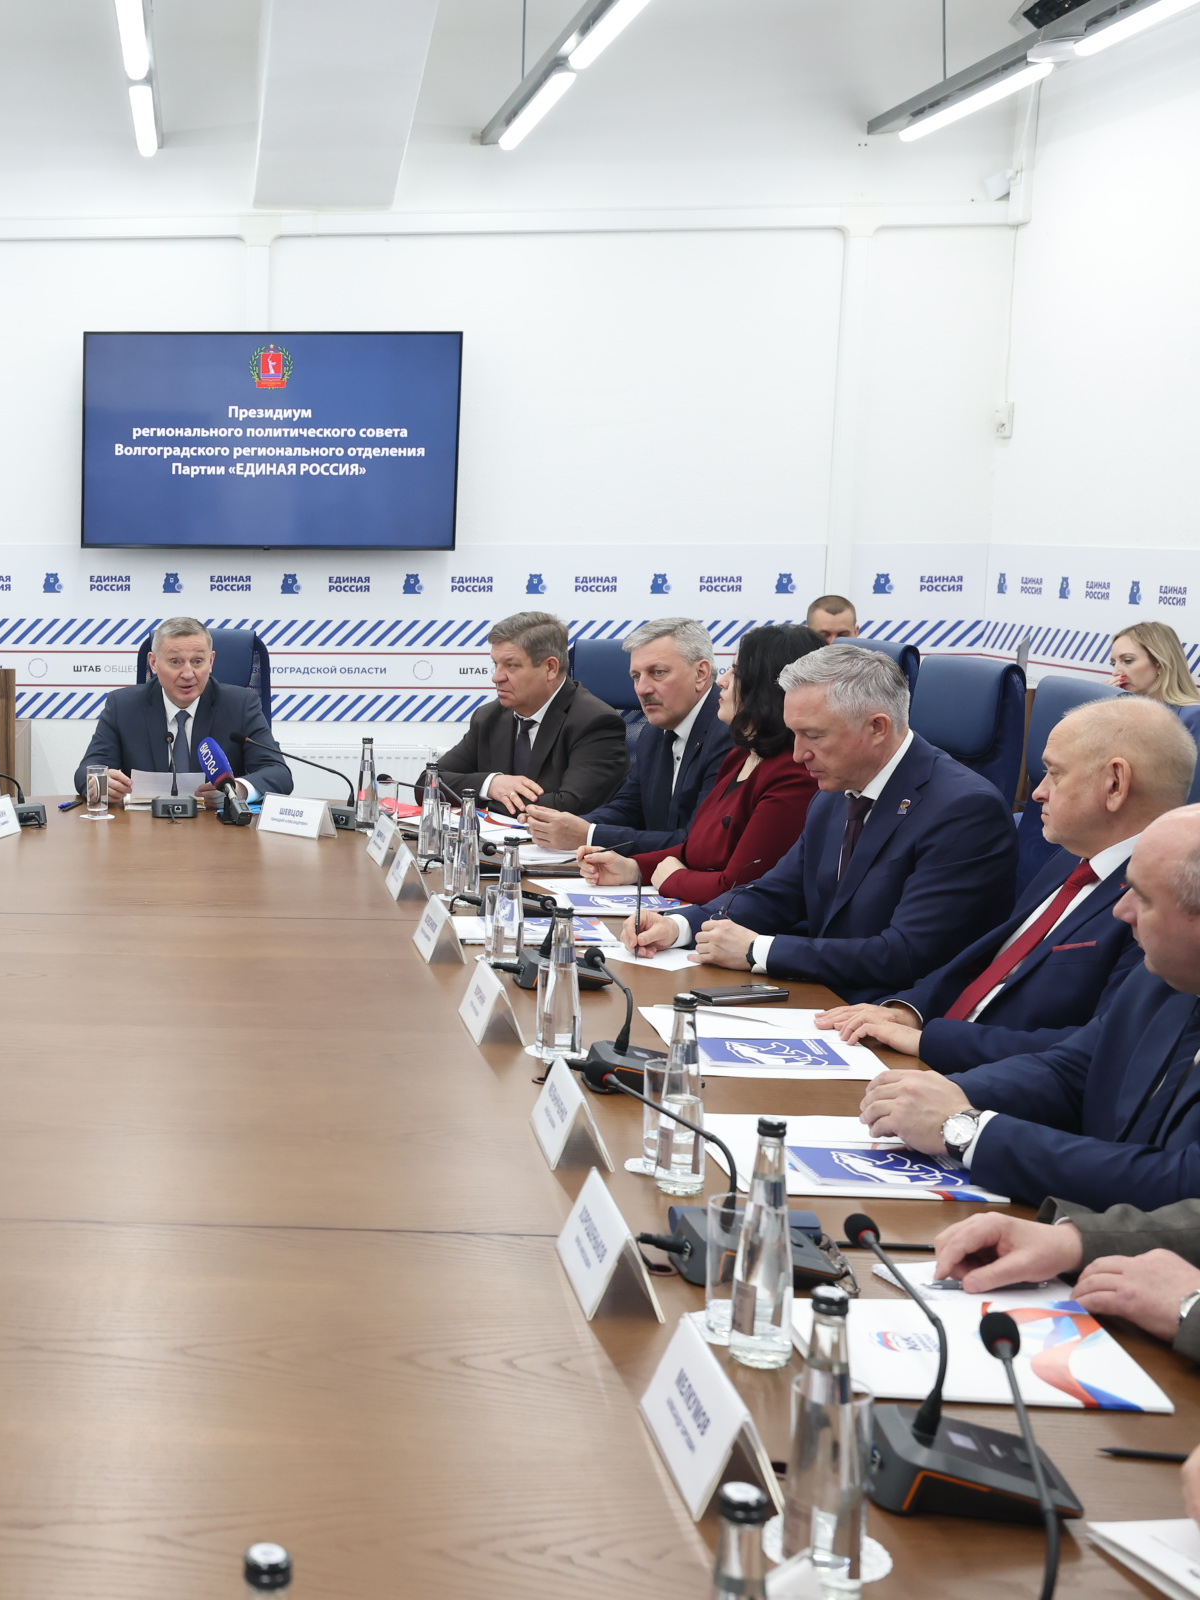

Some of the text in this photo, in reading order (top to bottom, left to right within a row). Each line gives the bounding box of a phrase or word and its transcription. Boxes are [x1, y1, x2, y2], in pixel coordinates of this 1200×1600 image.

[228, 406, 312, 422] Президиум
[132, 427, 408, 440] регионального политического совета
[114, 444, 426, 460] Волгоградского регионального отделения
[171, 463, 367, 478] Партии «ЕДИНАЯ РОССИЯ»
[89, 576, 130, 584] ЕДИНАЯ
[210, 576, 251, 584] ЕДИНАЯ
[328, 576, 370, 584] ЕДИНАЯ
[451, 577, 493, 585] ЕДИНАЯ
[575, 577, 617, 585] ЕДИНАЯ
[700, 576, 742, 584] ЕДИНАЯ
[920, 576, 963, 584] ЕДИНАЯ
[1021, 577, 1043, 585] ЕДИНАЯ
[89, 584, 130, 592] РОССИЯ
[210, 584, 251, 592] РОССИЯ
[328, 584, 370, 592] РОССИЯ
[451, 585, 493, 593] РОССИЯ
[575, 585, 617, 593] РОССИЯ
[700, 584, 742, 592] РОССИЯ
[920, 584, 963, 592] РОССИЯ
[1085, 581, 1111, 590] ЕДИНАЯ
[1020, 586, 1042, 595] РОССИЯ
[1159, 585, 1187, 595] ЕДИНАЯ
[1085, 591, 1110, 600] РОССИЯ
[1158, 596, 1186, 606] РОССИЯ
[73, 665, 101, 673] ШТАБ
[339, 666, 387, 675] ОБЛАСТИ
[459, 667, 488, 675] ШТАБ
[200, 742, 219, 776] РОССИЯ
[279, 808, 304, 818] ШЕВЦОВ
